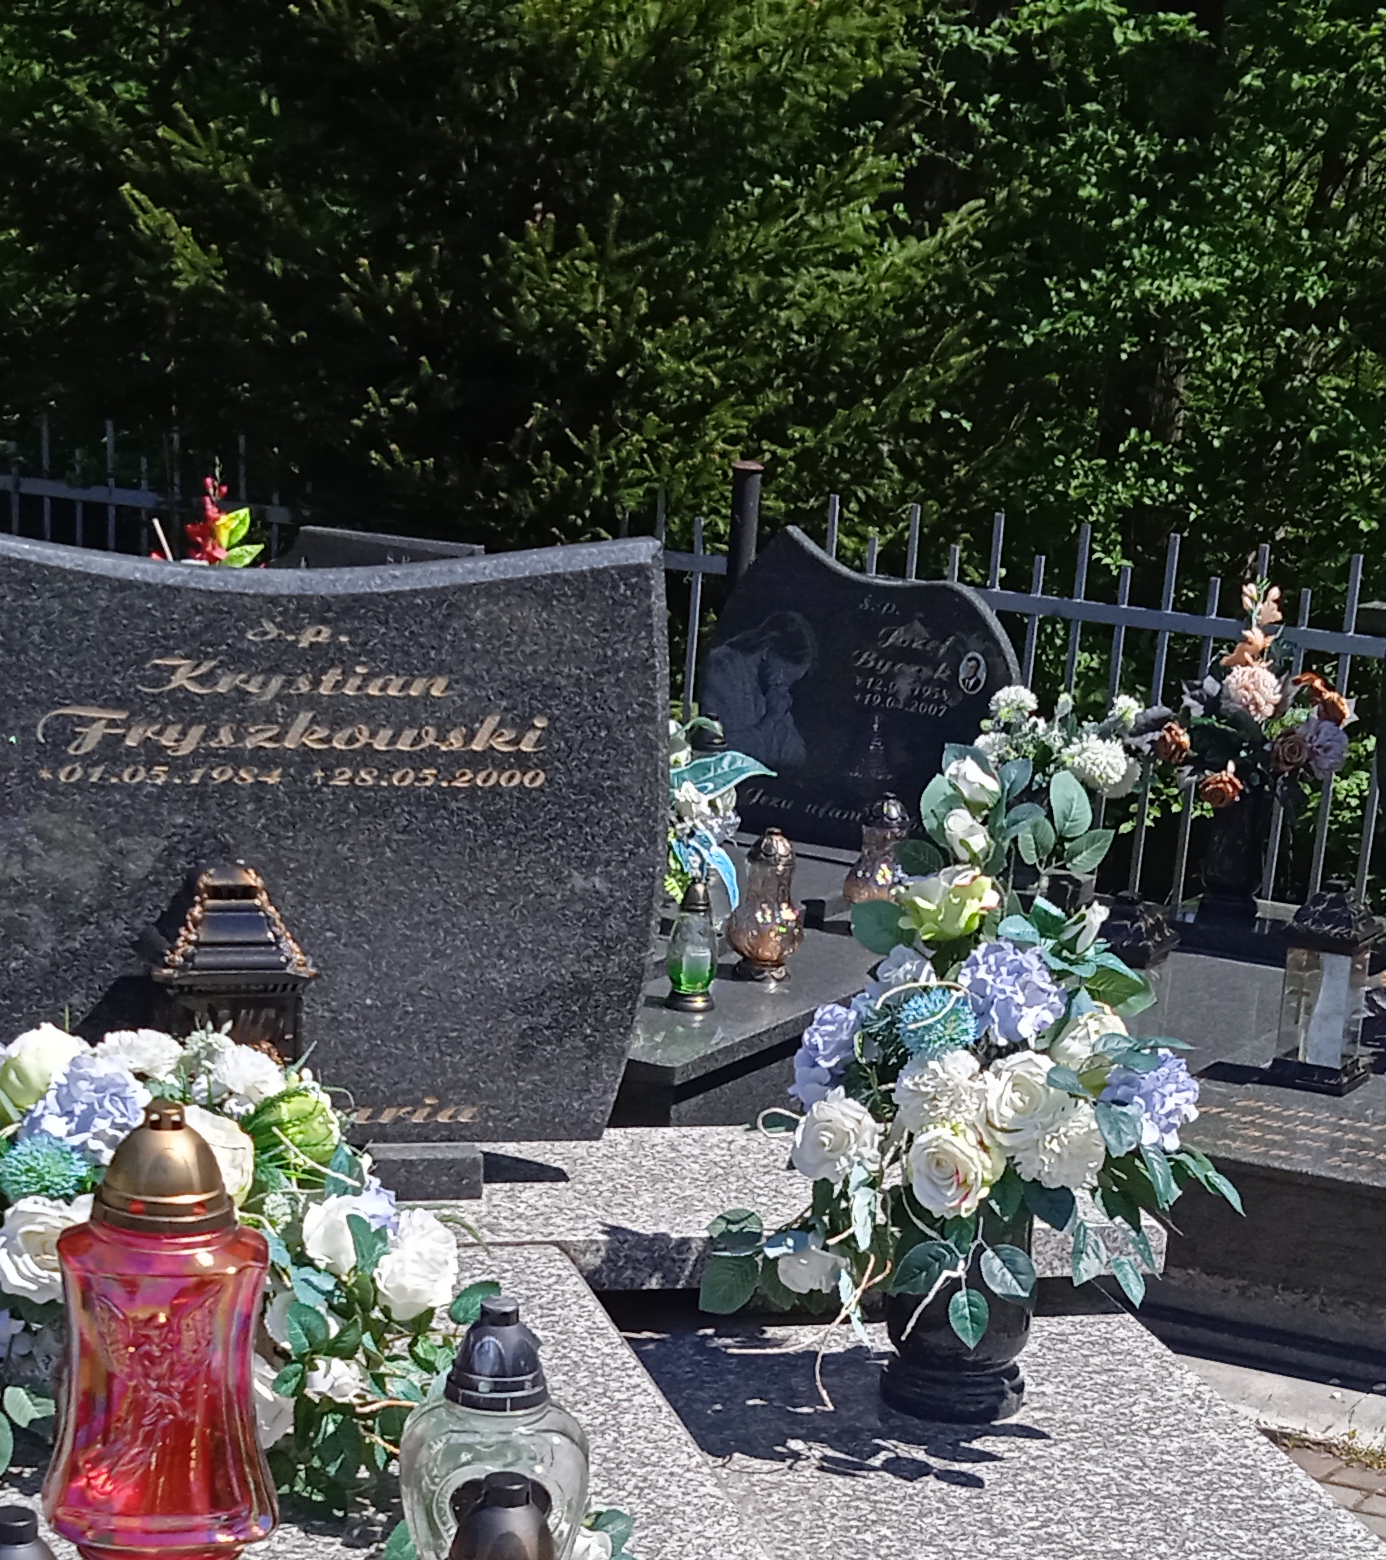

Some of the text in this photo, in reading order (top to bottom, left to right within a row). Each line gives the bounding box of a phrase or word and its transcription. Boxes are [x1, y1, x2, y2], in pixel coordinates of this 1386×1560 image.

[136, 654, 456, 701] Krystian
[35, 705, 550, 757] Fryszkowski
[343, 1095, 479, 1124] aria
